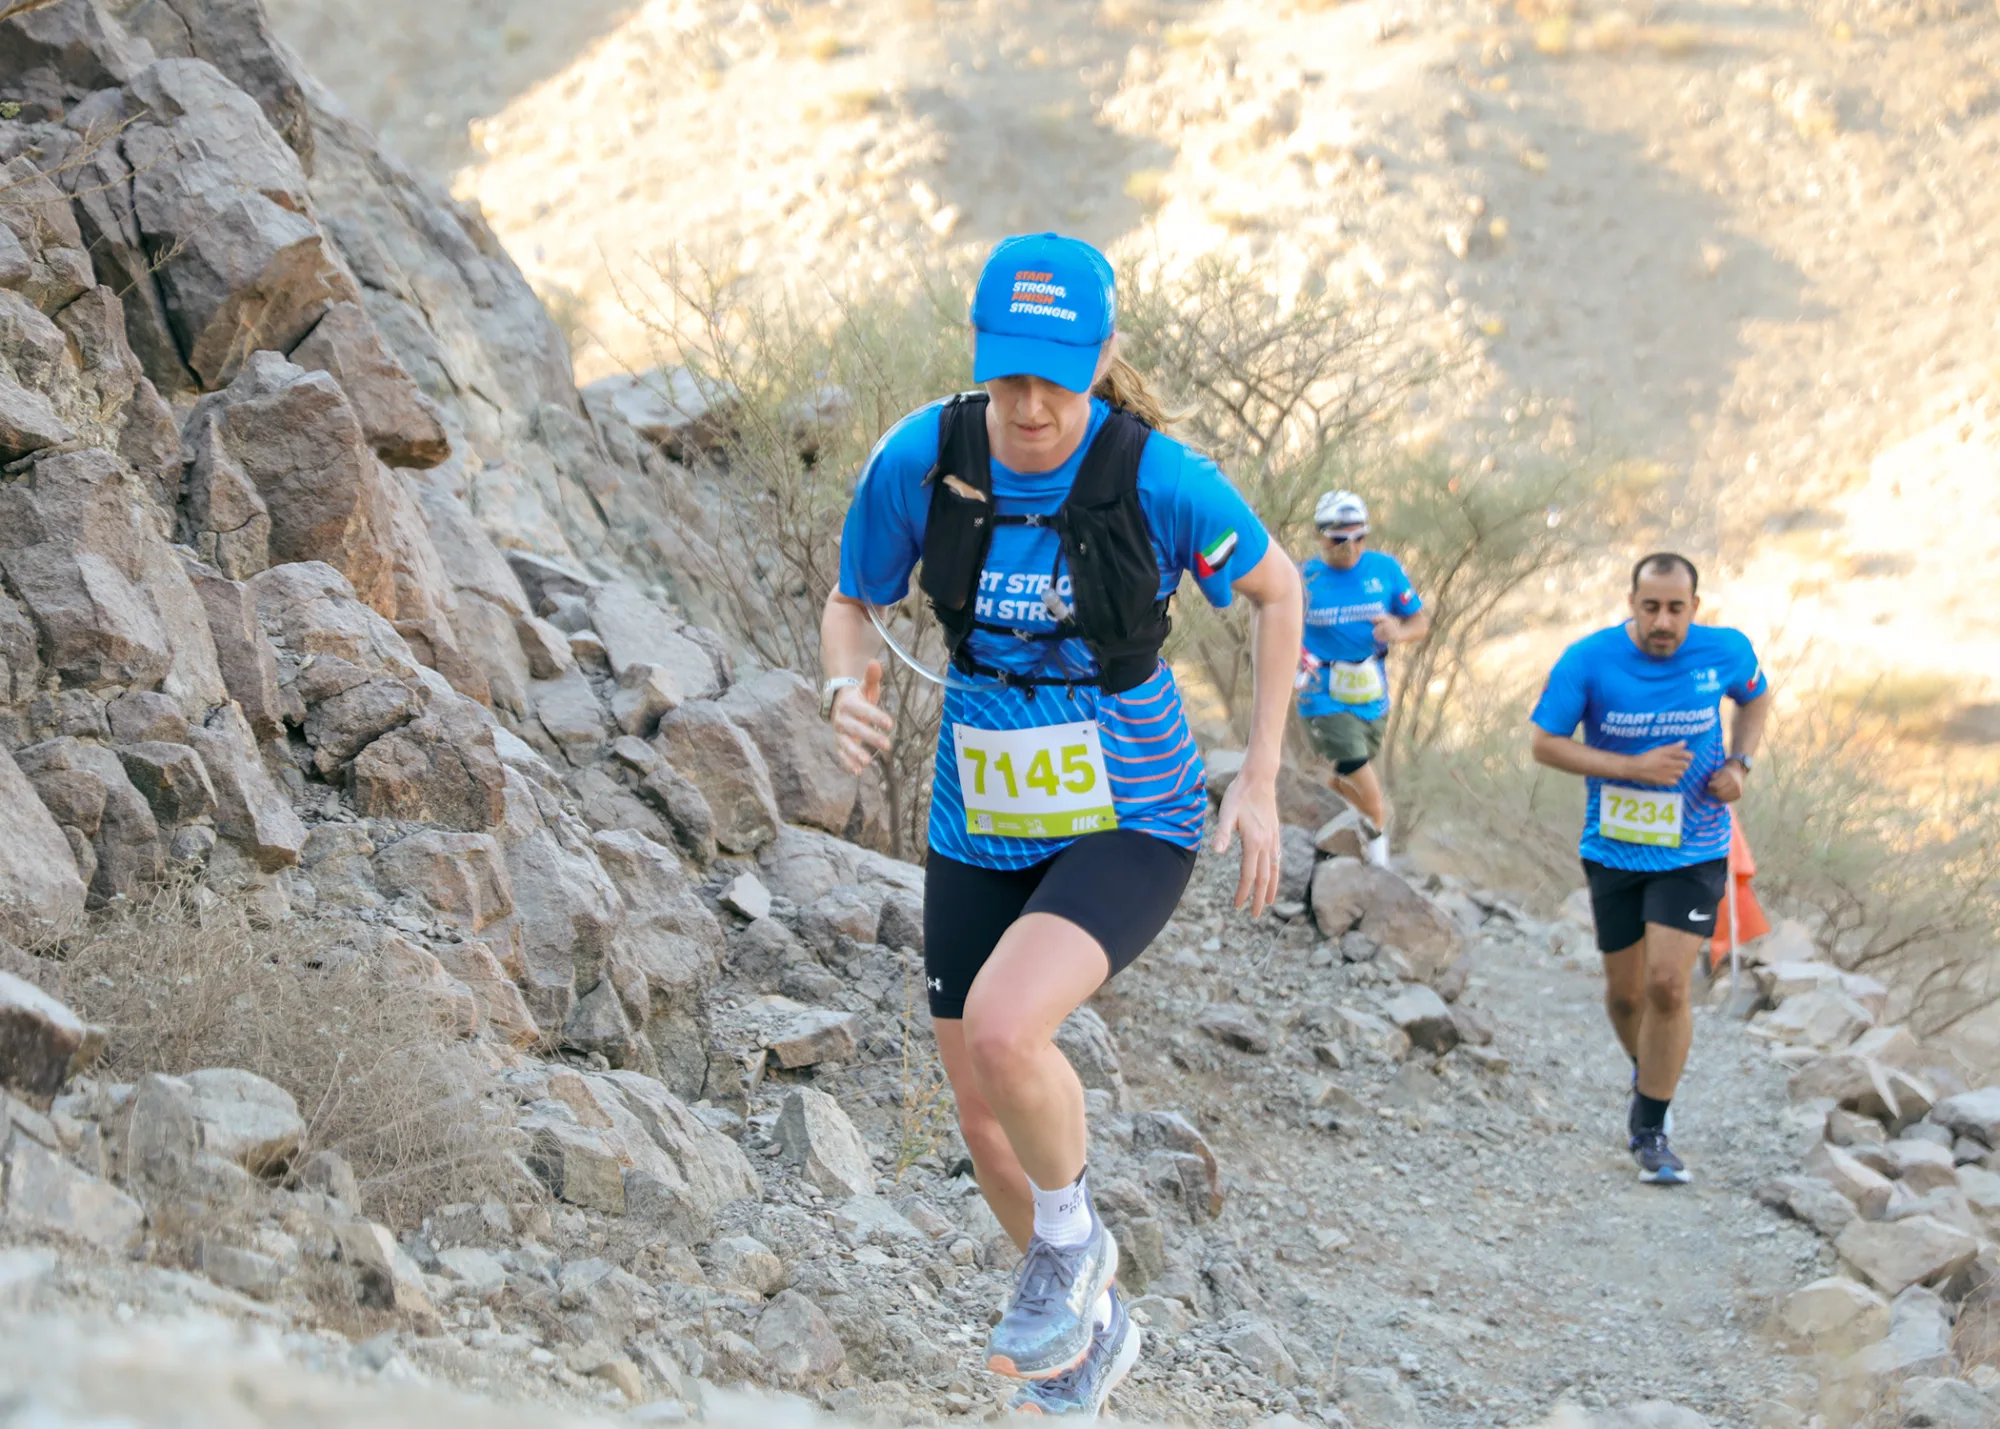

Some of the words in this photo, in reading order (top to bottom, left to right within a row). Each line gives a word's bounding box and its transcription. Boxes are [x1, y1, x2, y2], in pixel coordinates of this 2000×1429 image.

[1015, 271, 1053, 282] START
[1012, 292, 1054, 304] FINISH
[1010, 303, 1077, 321] STRONGER
[1606, 710, 1655, 725] START
[1600, 722, 1649, 738] FINISH
[963, 744, 1096, 798] 7145
[1607, 795, 1676, 826] 7234
